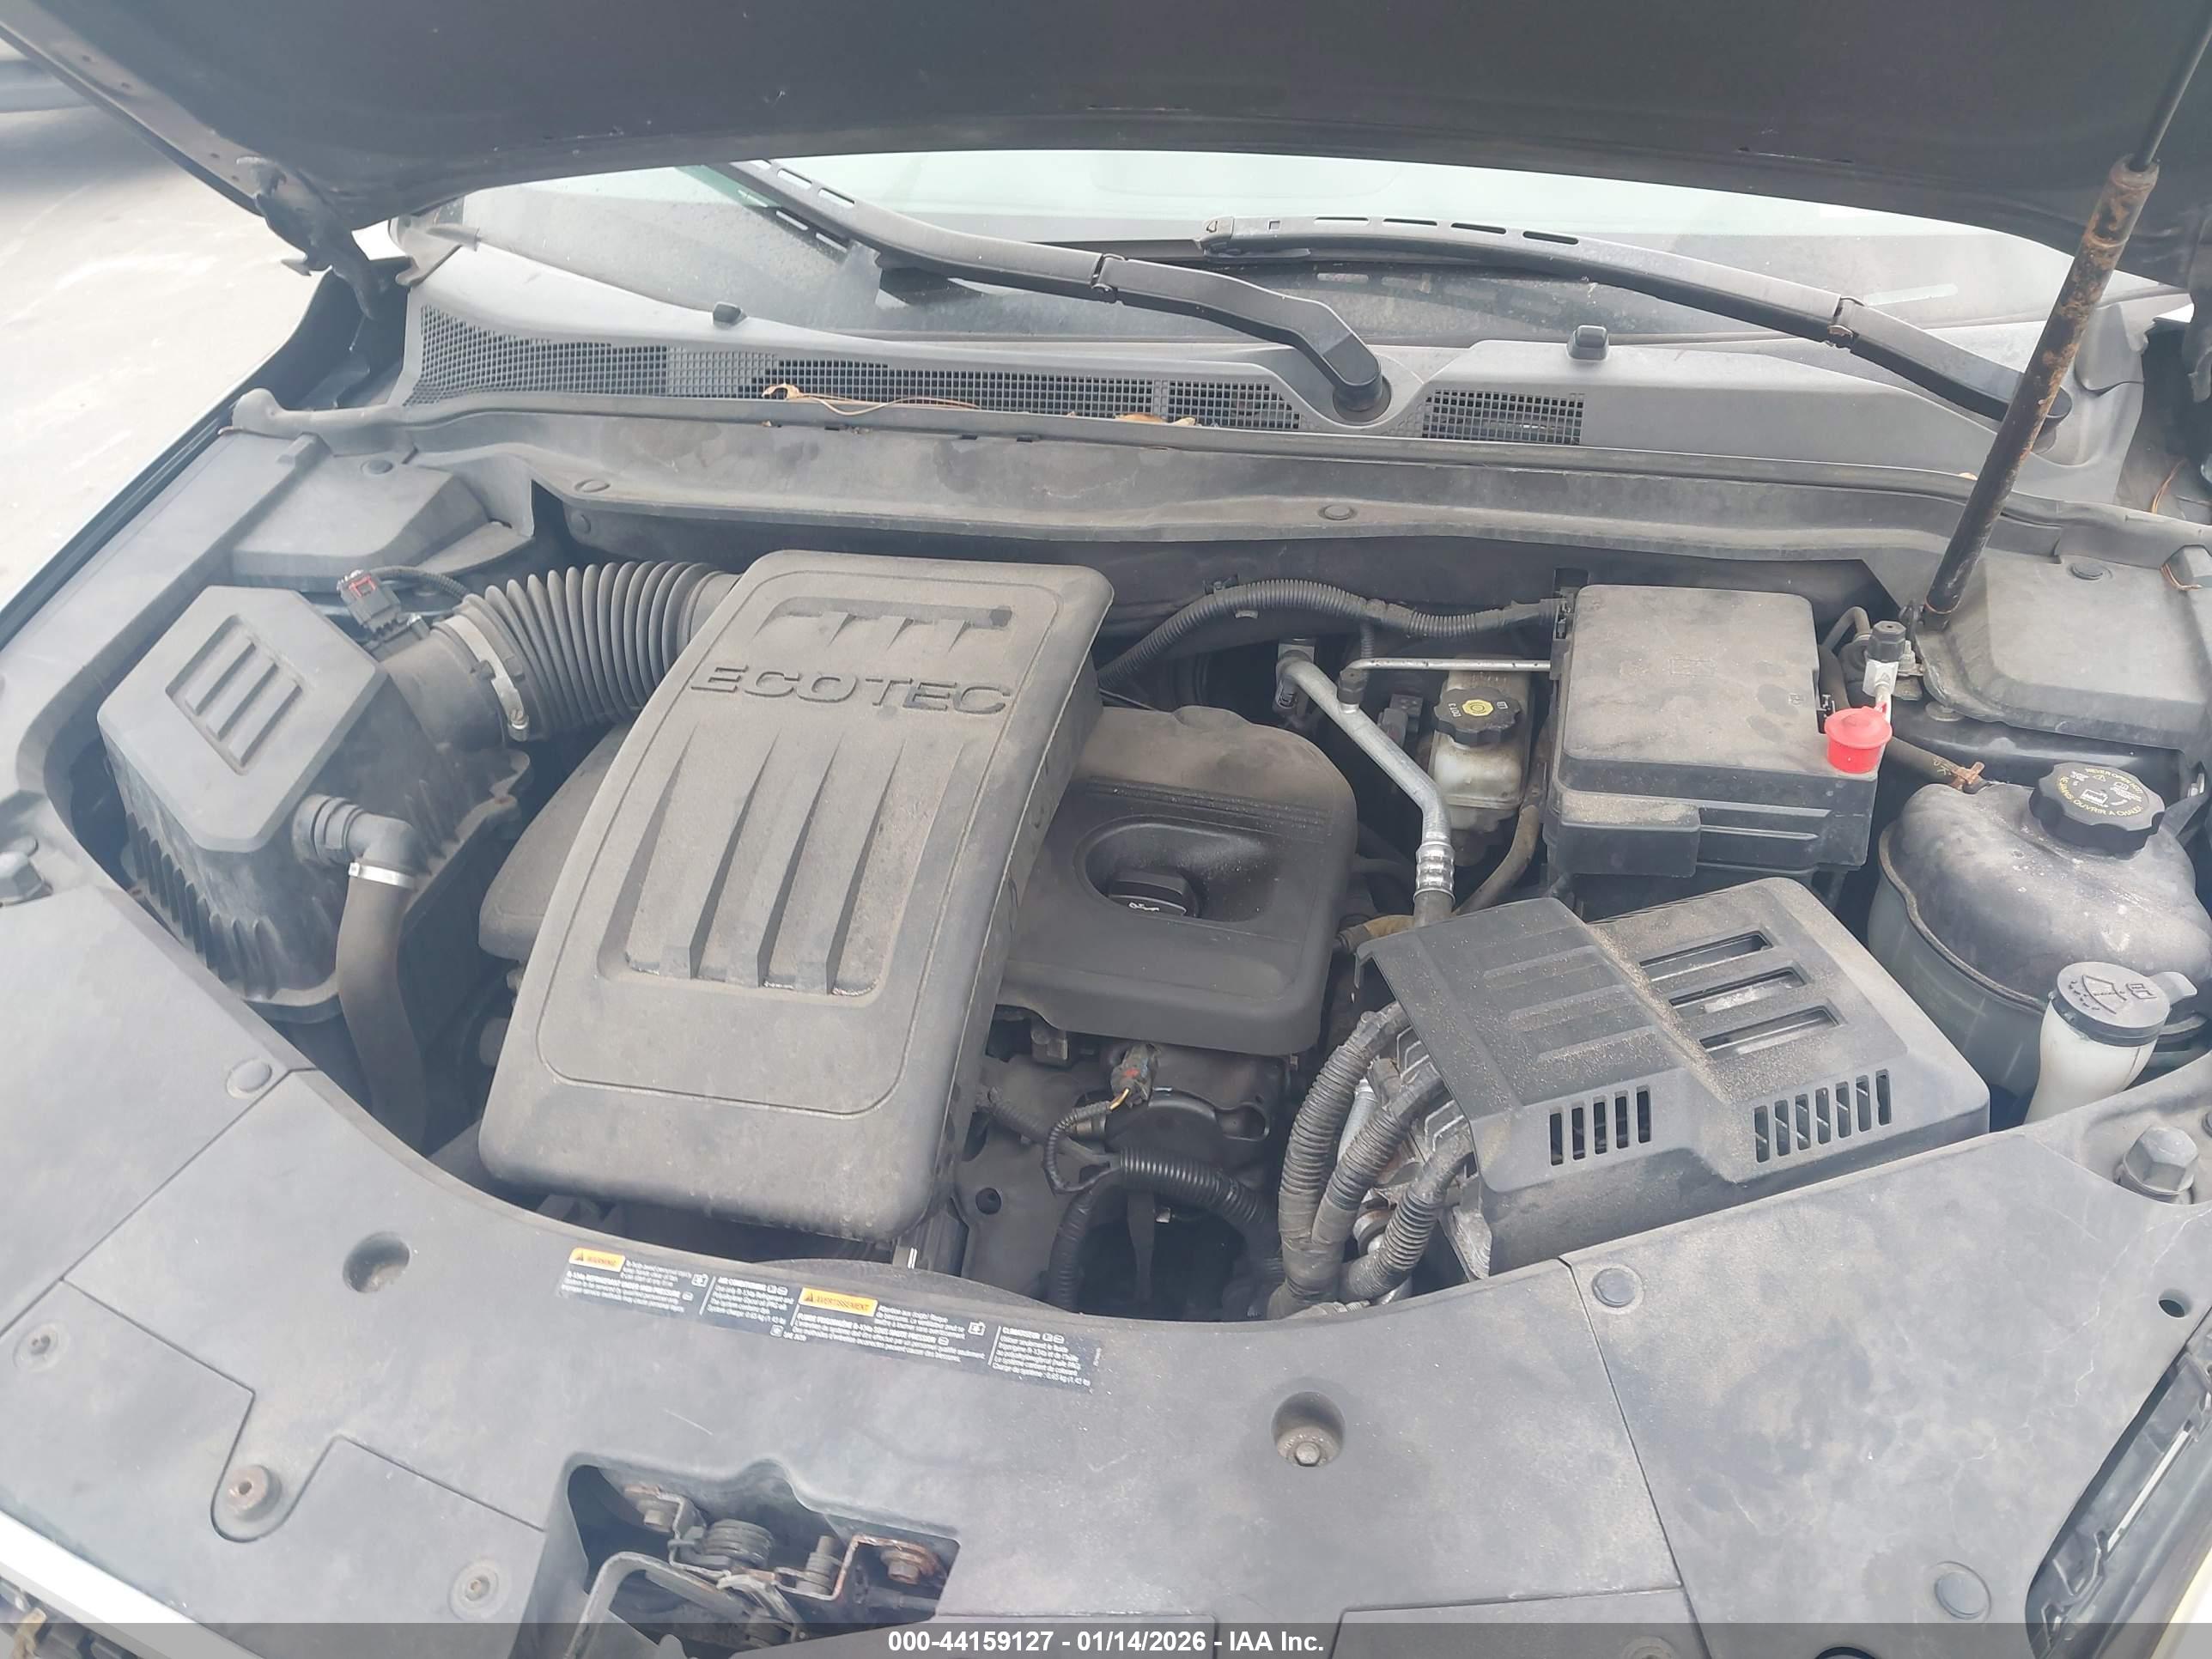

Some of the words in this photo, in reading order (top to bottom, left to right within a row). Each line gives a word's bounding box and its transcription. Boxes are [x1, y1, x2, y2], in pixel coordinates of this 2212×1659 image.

[690, 665, 1012, 716] ECOTEC
[2112, 773, 2131, 785] OPEN
[2074, 800, 2106, 814] OUVRIR
